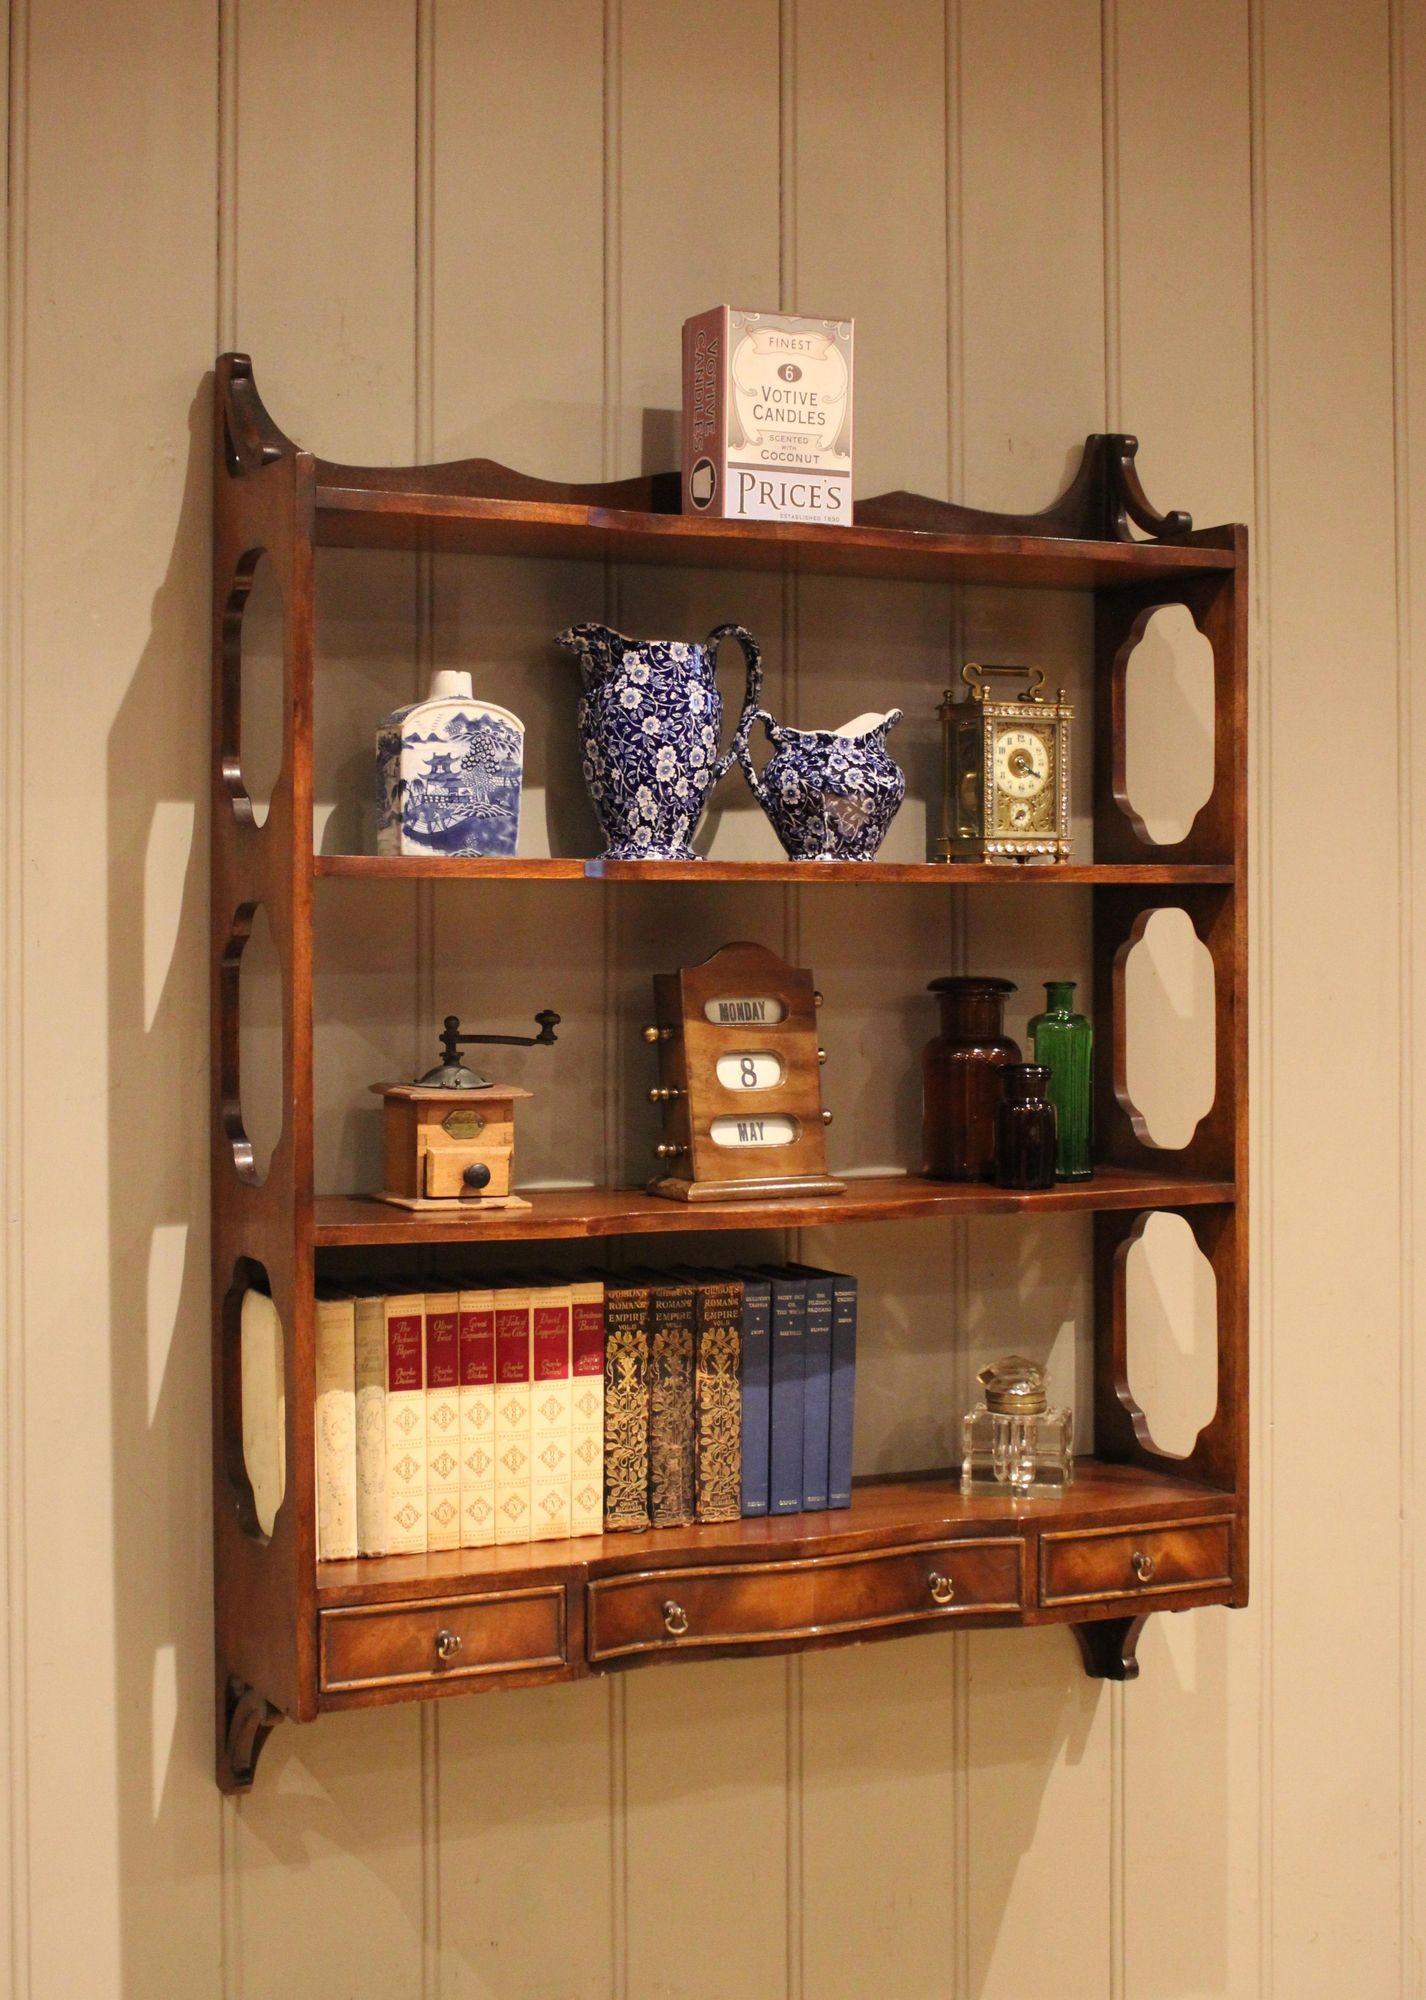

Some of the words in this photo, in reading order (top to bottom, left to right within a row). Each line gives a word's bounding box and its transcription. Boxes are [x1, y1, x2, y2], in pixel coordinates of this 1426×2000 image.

[769, 336, 812, 351] FINEST
[784, 365, 795, 381] 6
[694, 329, 706, 452] CANDLES
[704, 336, 720, 437] VOTIVE
[762, 386, 818, 406] VOTIVE
[753, 404, 826, 426] CANDLES
[769, 434, 808, 444] SCENTED
[760, 450, 820, 464] COCONUT
[738, 472, 841, 514] PRICE'S
[780, 514, 821, 522] ESTABLISHED
[718, 1001, 766, 1022] MONDAY
[740, 1057, 757, 1088] 8
[737, 1122, 764, 1142] MAY
[608, 1312, 646, 1322] EMPIRE
[656, 1312, 692, 1322] EMPIRE
[704, 1310, 739, 1320] EMPIRE
